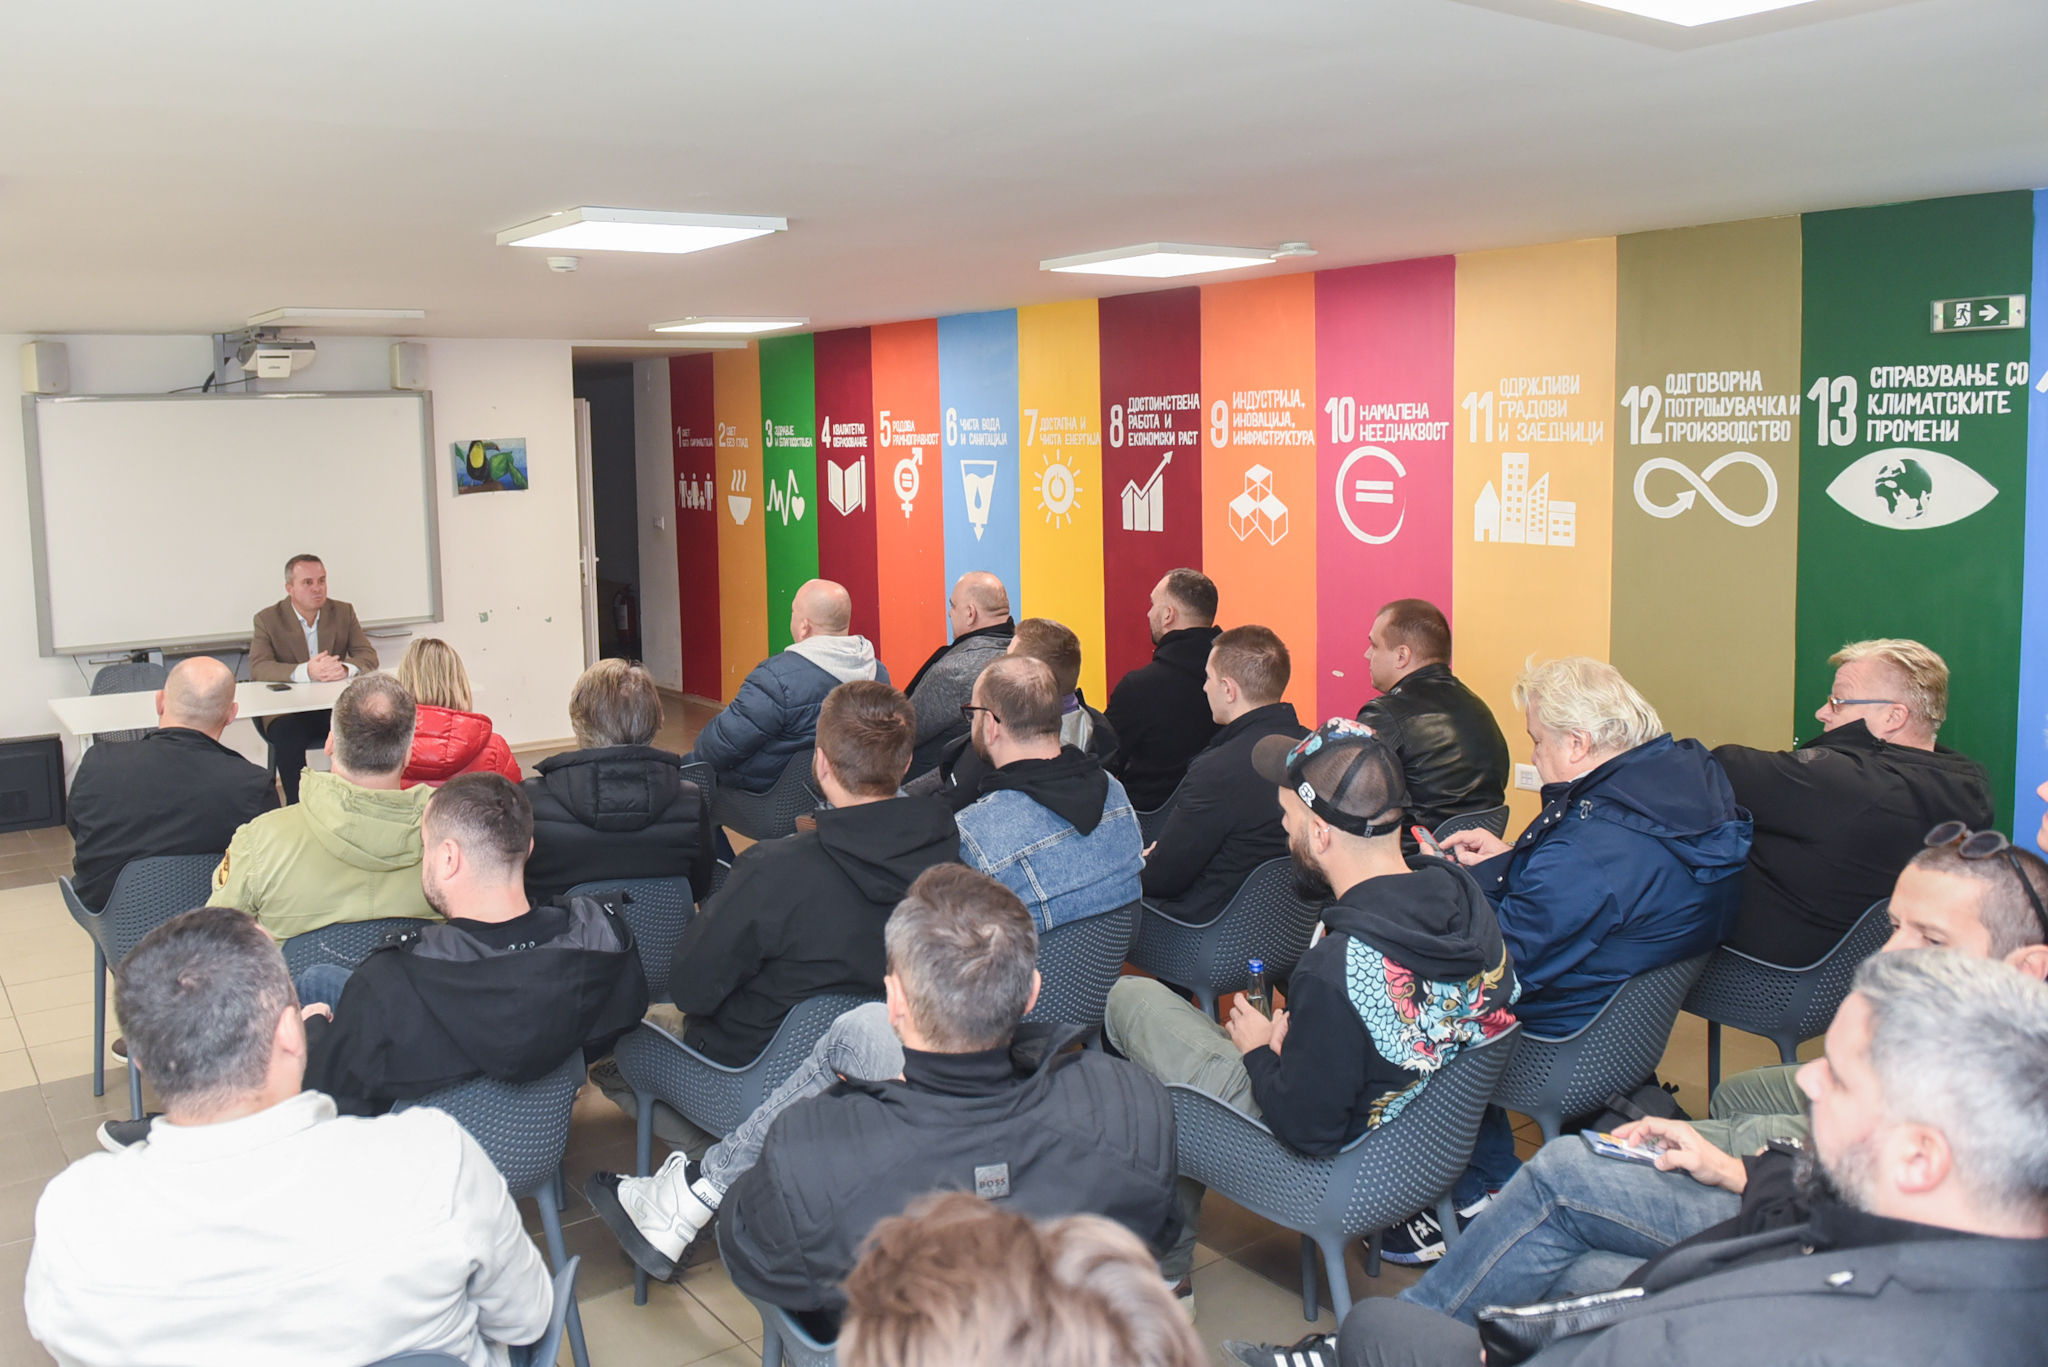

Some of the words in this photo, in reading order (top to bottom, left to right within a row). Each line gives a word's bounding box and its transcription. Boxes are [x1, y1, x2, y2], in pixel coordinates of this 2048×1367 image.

[1499, 374, 1580, 399] ОДРЖЛИВИ
[1665, 370, 1763, 396] ОДГОВОРНА
[1870, 362, 2000, 389] СПРАВУВАЊЕ
[2005, 361, 2029, 387] СО
[1127, 393, 1200, 414] ДОСТОИНСТВЕНА
[1232, 389, 1306, 412] ИНДУСТРИЈА,
[1359, 402, 1430, 421] НАМАЛЕНА
[1498, 399, 1568, 420] ГРАДОВИ
[1664, 395, 1788, 418] ПОТРОШУВАЧКА
[1789, 394, 1801, 416] И
[1806, 375, 1858, 447] 13
[1867, 390, 2012, 416] КЛИМАТСКИТЕ
[892, 420, 916, 433] РОДОВА
[946, 407, 958, 447] 6
[960, 418, 980, 431] ЧИСТА
[981, 417, 1001, 432] ВОДА
[1039, 417, 1078, 432] ДОСТАПНА
[1080, 416, 1087, 430] И
[1109, 404, 1124, 448] 8
[1128, 414, 1160, 430] РАБОТА
[1164, 413, 1172, 429] И
[1210, 399, 1229, 449] 9
[1232, 411, 1296, 430] ИНОВАЦИЈА,
[1324, 396, 1356, 444] 10
[1461, 391, 1494, 443] 11
[1620, 385, 1663, 445] 12
[677, 426, 681, 448] 1
[718, 422, 726, 447] 2
[765, 419, 773, 448] 3
[821, 416, 831, 448] 4
[880, 410, 891, 447] 5
[960, 433, 966, 446] И
[968, 432, 1008, 447] САНИТАЦИЈА
[1024, 408, 1039, 447] 7
[1039, 433, 1062, 446] ЧИСТА
[1064, 432, 1101, 446] ЕНЕРГИЈА
[1128, 431, 1176, 447] ЕКОНОМСКИ
[1178, 430, 1199, 446] РАСТ
[1232, 429, 1316, 446] ИНФРАСТРУКТУРА
[1359, 421, 1450, 443] НЕЕДНАКВОСТ
[1498, 422, 1509, 442] И
[1516, 421, 1604, 446] ЗАЕДНИЦИ
[1664, 420, 1791, 444] ПРОИЗВОДСТВО
[1866, 418, 1960, 443] ПРОМЕНИ
[979, 1177, 1006, 1189] BOSS
[699, 1191, 719, 1208] DIES
